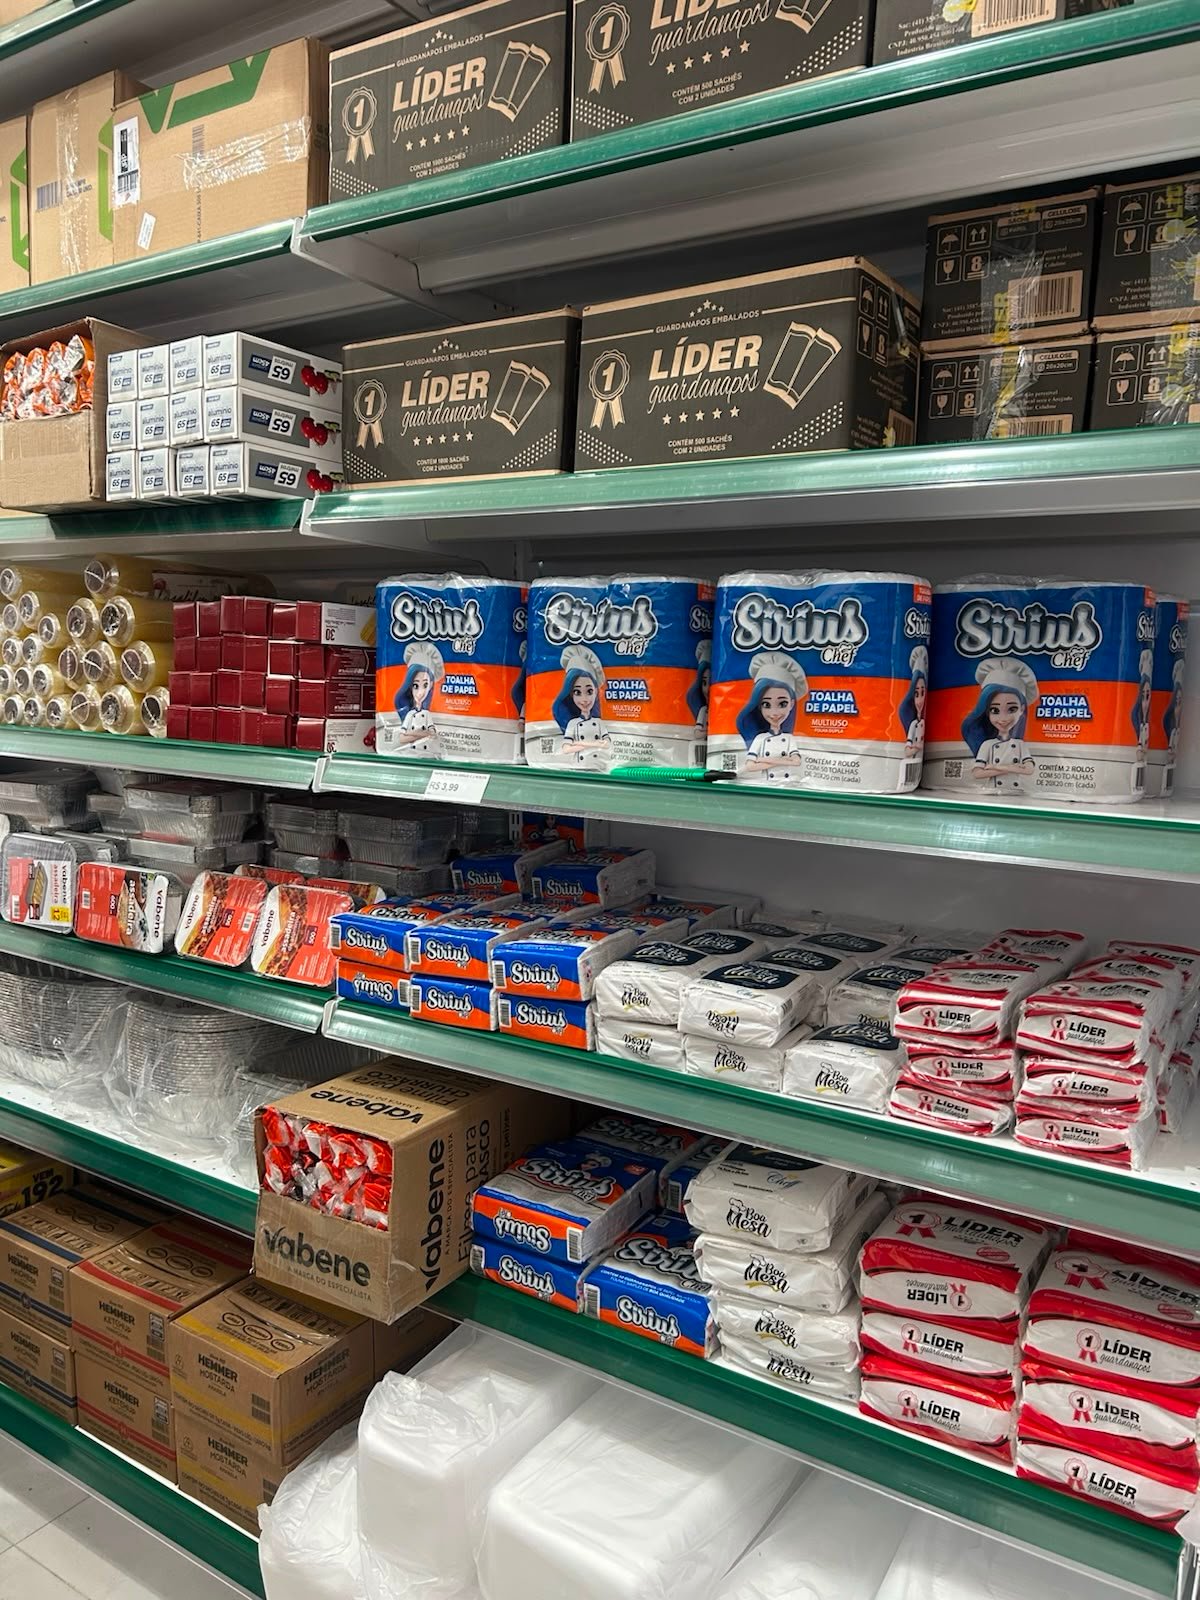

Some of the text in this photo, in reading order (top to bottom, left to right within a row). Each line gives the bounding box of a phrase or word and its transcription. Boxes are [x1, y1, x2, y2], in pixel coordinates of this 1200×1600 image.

[599, 16, 615, 50] 1
[649, 0, 773, 66] guardanapos
[396, 34, 484, 67] GUARDANAPOS EMBALADOS
[392, 56, 487, 112] LÍDER
[671, 71, 743, 99] CONTÉM 500 SACHÊS
[677, 95, 694, 106] COM
[699, 83, 736, 99] UNIDADES
[353, 98, 365, 128] 1
[392, 88, 486, 144] guardanapos
[655, 310, 760, 334] GUARDANAPOS EMBALADOS
[210, 364, 220, 374] 65
[405, 349, 488, 368] GUARDANAPOS EMBALADOS
[649, 335, 763, 381] LÍDER
[271, 365, 291, 380] 65
[602, 361, 615, 391] 1
[401, 370, 491, 407] LÍDER
[647, 368, 761, 414] guardanapos
[364, 390, 376, 416] 1
[176, 419, 186, 429] 65
[211, 418, 220, 428] 65
[271, 418, 291, 434] 65
[400, 400, 488, 436] guardanapos
[667, 434, 733, 448] CONTÉM 500 SACHÊS
[672, 447, 688, 456] COM
[695, 442, 726, 454] UNIDADES
[217, 472, 227, 483] 65
[277, 470, 297, 487] 65
[391, 593, 484, 641] Sirius
[546, 593, 658, 645] Sirius
[733, 594, 868, 651] Sirius
[955, 598, 1102, 657] Sirius
[614, 637, 648, 658] Chef
[821, 644, 856, 666] Chef
[1051, 648, 1089, 670] Chef
[441, 684, 478, 695] DE PAPEL
[446, 675, 476, 686] TOALHA
[607, 680, 646, 690] TOALHA
[605, 691, 650, 700] DE PAPEL
[811, 692, 853, 702] TOALHA
[1041, 696, 1087, 706] TOALHA
[806, 703, 858, 714] DE PAPEL
[1037, 708, 1091, 718] DE PAPEL
[812, 719, 848, 727] MULTIUSO
[1042, 723, 1081, 732] MULTIUSO
[805, 757, 831, 766] CONTÉM
[829, 767, 859, 776] TOALHAS
[1039, 764, 1064, 772] CONTÉM
[441, 782, 459, 792] 3,99
[1062, 773, 1094, 781] TOALHAS
[1075, 781, 1096, 790] (cada)
[466, 871, 504, 888] Sirius
[547, 879, 583, 897] Sirius
[52, 907, 60, 921] 12
[125, 879, 137, 936] assadeira
[153, 889, 164, 938] vabene
[184, 894, 200, 930] vabene
[201, 896, 218, 936] assadeira
[262, 909, 275, 947] vabene
[281, 911, 297, 953] assadeira
[346, 928, 389, 952] Sirius
[426, 941, 471, 964] Sirius
[511, 963, 560, 986] Sirius
[354, 976, 394, 1003] Sirius
[426, 989, 474, 1013] Sirius
[622, 991, 651, 1007] Mesa
[517, 1004, 568, 1029] Sirius
[706, 1010, 740, 1037] Mesa
[938, 1009, 971, 1022] LÍDER
[1069, 1020, 1107, 1038] LÍDER
[715, 1052, 748, 1073] Mesa
[951, 1061, 984, 1071] LÍDER
[352, 1075, 400, 1090] para
[815, 1072, 851, 1095] Mesa
[832, 1071, 849, 1084] Boa
[1071, 1080, 1109, 1095] LÍDER
[311, 1090, 425, 1125] vabene
[936, 1097, 969, 1114] LÍDER
[1063, 1125, 1100, 1138] LÍDER
[517, 1157, 617, 1198] Sirius
[22, 1175, 64, 1208] 192
[420, 1138, 446, 1293] vabene
[727, 1208, 772, 1238] Mesa
[746, 1206, 768, 1222] Boa
[493, 1214, 552, 1255] Sirius
[943, 1216, 1025, 1244] LÍDER
[8, 1253, 39, 1276] HEMMER
[262, 1226, 371, 1288] vabene
[500, 1256, 556, 1297] Sirius
[744, 1263, 790, 1294] Mesa
[764, 1263, 787, 1279] Boa
[1112, 1268, 1200, 1303] LÍDER
[907, 1289, 948, 1306] LÍDER
[99, 1301, 136, 1326] HEMMER
[618, 1295, 682, 1339] Sirius
[755, 1318, 799, 1350] Mesa
[774, 1319, 796, 1336] Boa
[922, 1331, 965, 1354] LÍDER
[1103, 1338, 1152, 1363] LÍDER
[198, 1353, 238, 1383] HEMMER
[303, 1347, 351, 1386] HEMMER
[766, 1356, 814, 1385] Mesa
[1100, 1352, 1151, 1374] guardanapos
[200, 1369, 236, 1394] MOSTARDA
[104, 1380, 140, 1408] HEMMER
[919, 1400, 961, 1423] LÍDER
[1093, 1411, 1142, 1433] guardanapos
[1095, 1401, 1141, 1424] LÍDER
[207, 1437, 249, 1467] HEMMER
[209, 1451, 247, 1479] MOSTARDA
[1090, 1471, 1137, 1500] LÍDER
